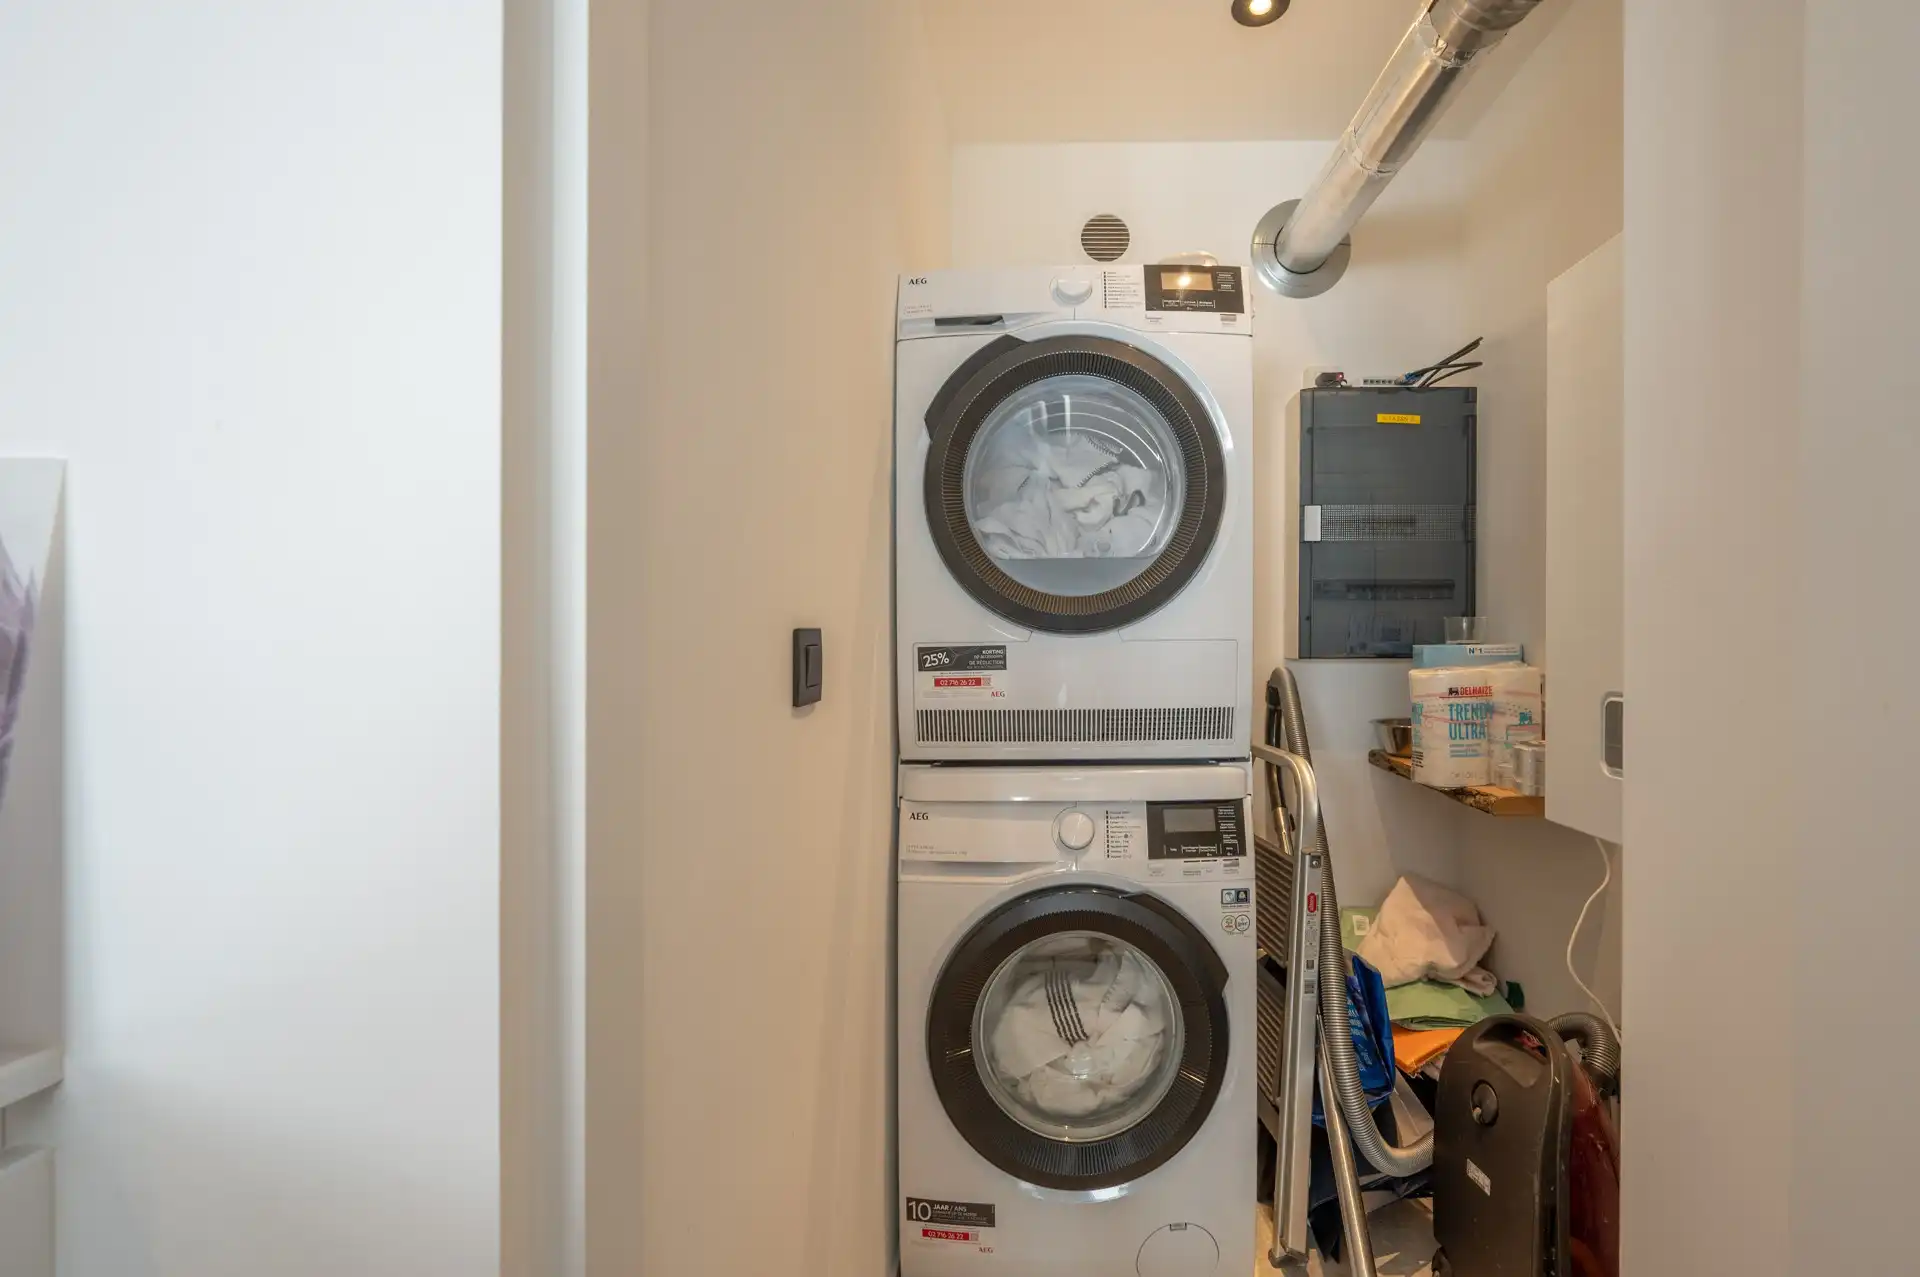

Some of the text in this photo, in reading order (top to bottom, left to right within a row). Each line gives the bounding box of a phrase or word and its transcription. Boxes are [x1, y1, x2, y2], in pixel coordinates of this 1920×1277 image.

[923, 652, 950, 668] 25%
[1460, 686, 1493, 696] DELHAIZE
[1449, 722, 1486, 740] ULTRA
[909, 812, 929, 820] AEG
[908, 1201, 932, 1221] 10
[954, 1205, 967, 1213] ANS
